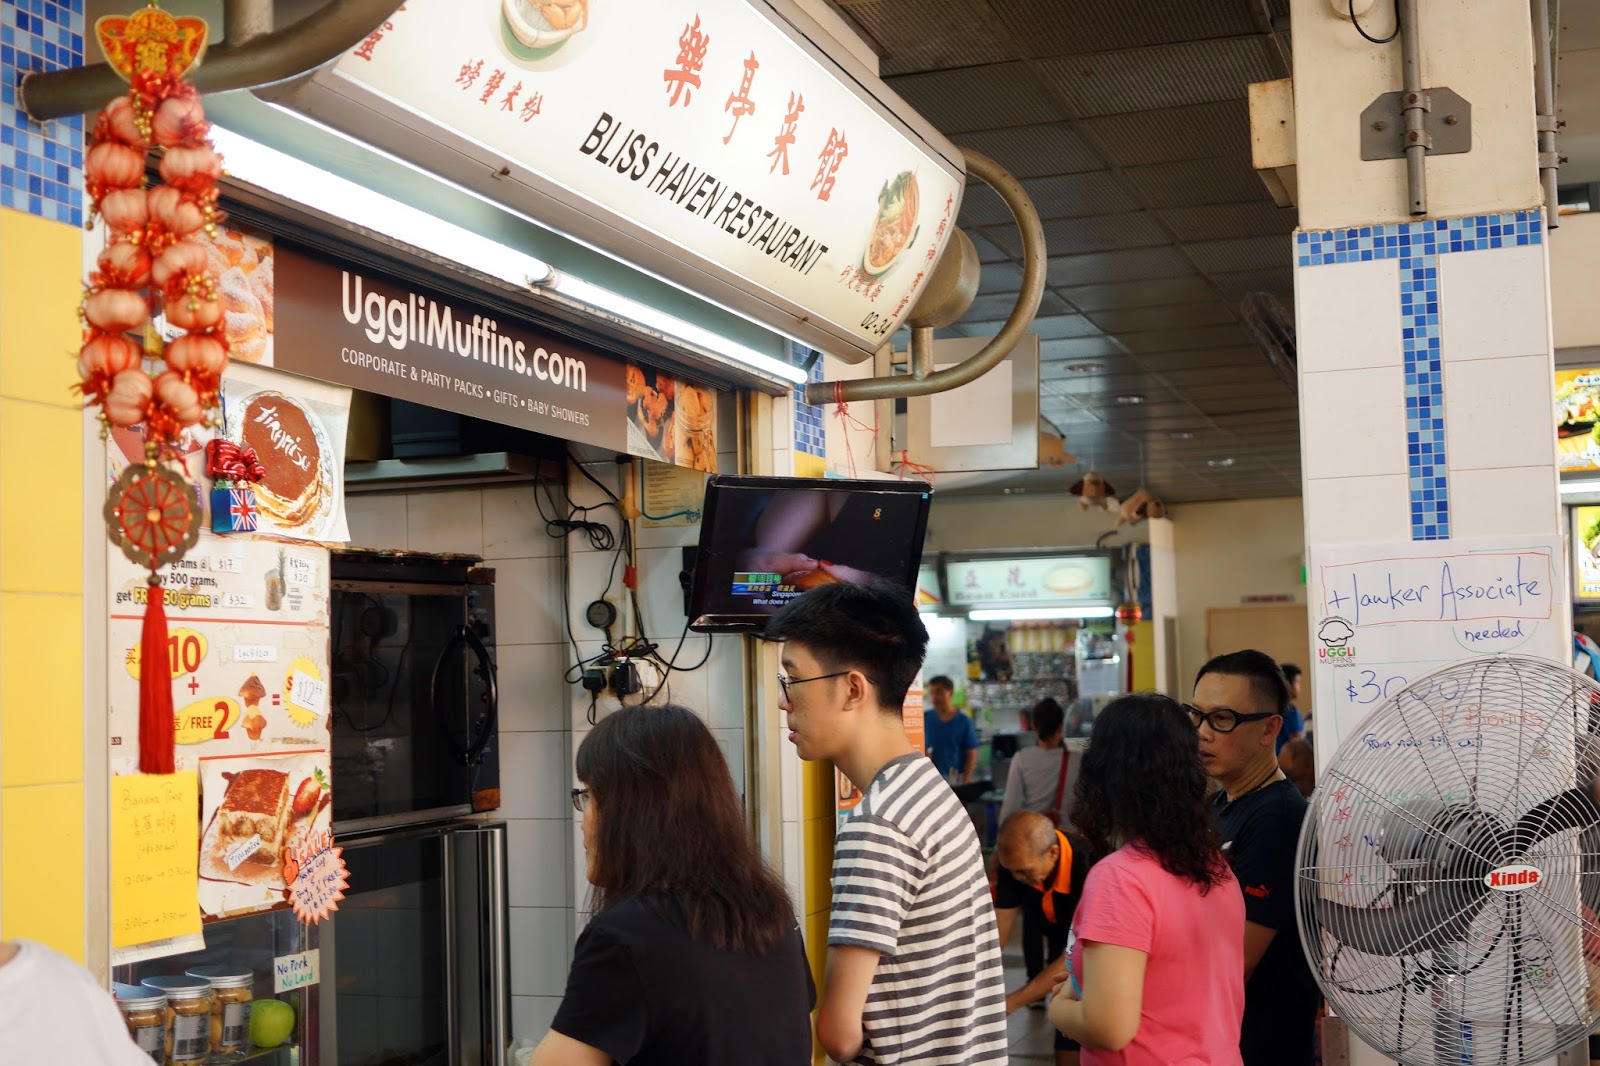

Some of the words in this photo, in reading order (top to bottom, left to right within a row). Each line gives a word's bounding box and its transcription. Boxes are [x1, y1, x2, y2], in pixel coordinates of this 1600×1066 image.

[578, 111, 660, 182] BLISS
[646, 151, 729, 220] HAVEN
[713, 190, 830, 276] RESTAURANT
[341, 270, 588, 393] UggliMuffins.com
[341, 347, 407, 379] CORPORATE
[410, 366, 419, 382] &
[421, 369, 452, 391] PARTY
[454, 377, 484, 399] PACKS
[493, 389, 519, 409] GIFTS
[527, 398, 550, 417] BABY
[551, 401, 591, 427] SHOWERS
[171, 558, 198, 571] grams
[170, 572, 188, 585] 500
[116, 590, 132, 604] get
[179, 592, 211, 609] grams
[1328, 573, 1430, 626] Hawker
[1440, 556, 1542, 621] Associate
[1464, 619, 1525, 642] needed
[167, 634, 202, 674] 10
[1319, 646, 1356, 658] UGGLI
[1320, 657, 1353, 665] MUFFINS
[190, 715, 213, 730] FREE
[213, 700, 230, 740] 2
[1489, 869, 1539, 887] Xinda
[276, 963, 289, 976] No
[289, 956, 309, 972] Pork
[281, 976, 294, 989] No
[294, 971, 314, 986] Lard
